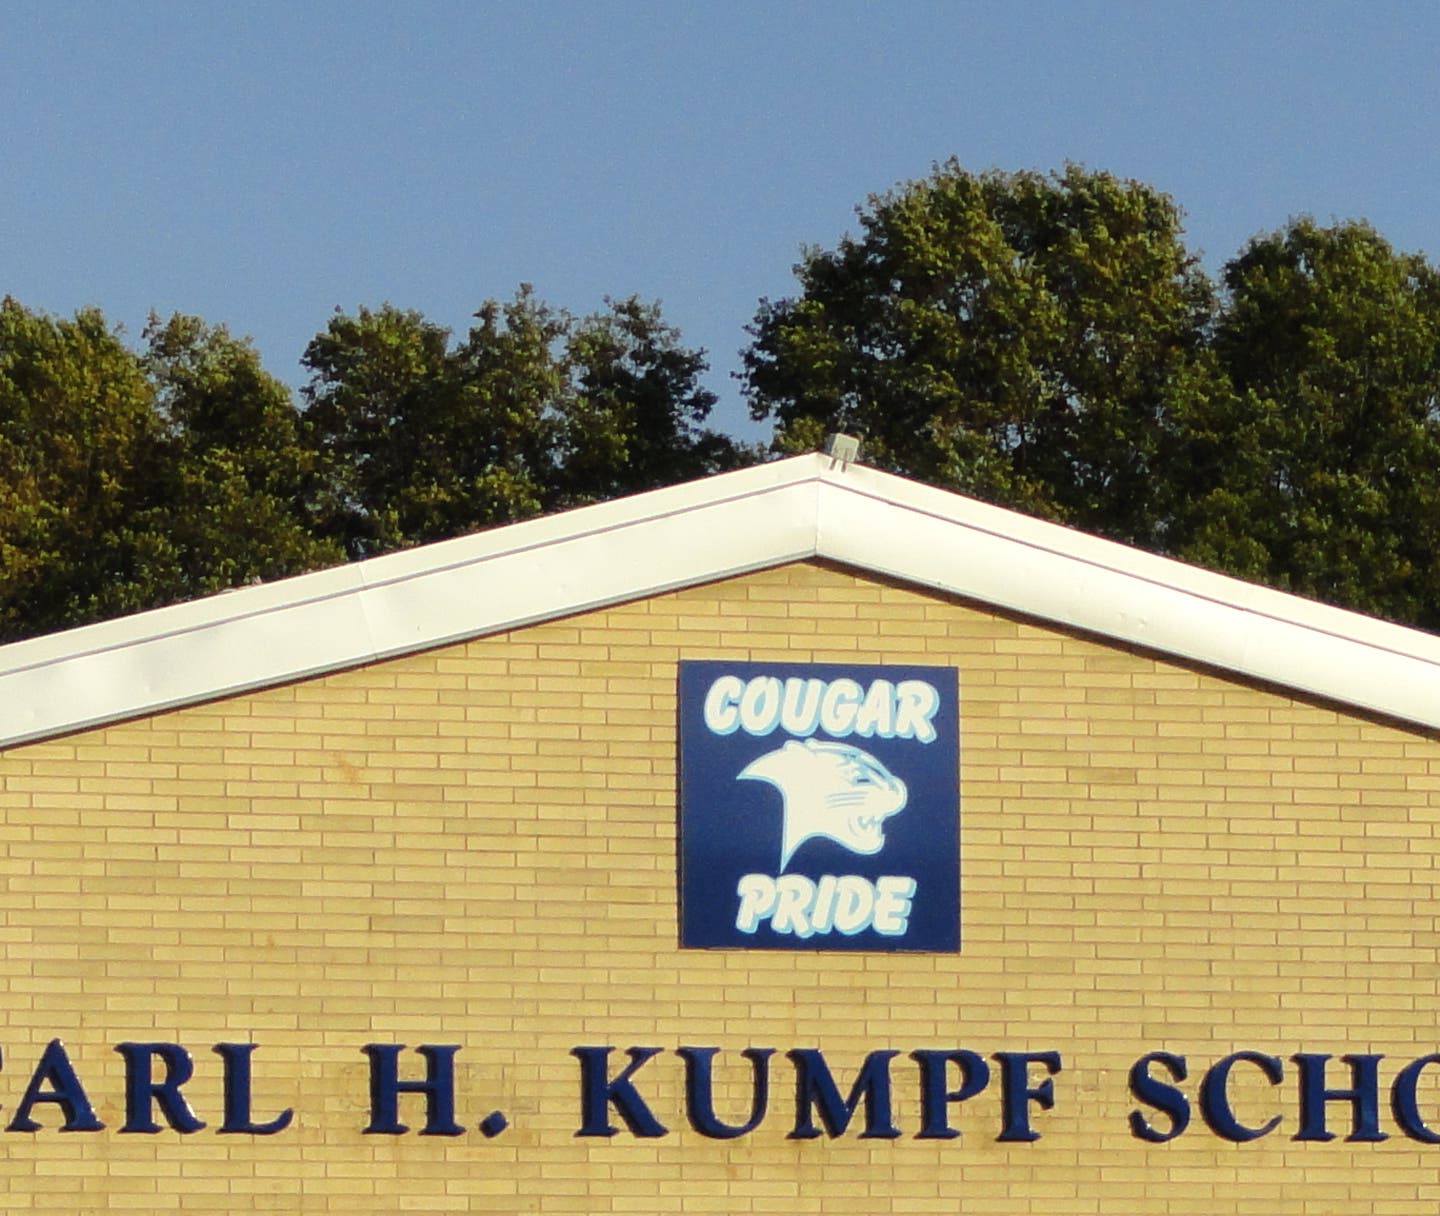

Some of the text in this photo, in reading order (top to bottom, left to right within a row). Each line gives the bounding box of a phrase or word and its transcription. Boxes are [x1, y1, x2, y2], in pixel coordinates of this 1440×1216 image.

[704, 675, 940, 744] COUGAR
[735, 873, 917, 938] PRIDE
[361, 1043, 509, 1139] H.
[570, 1046, 1062, 1142] KUMPF
